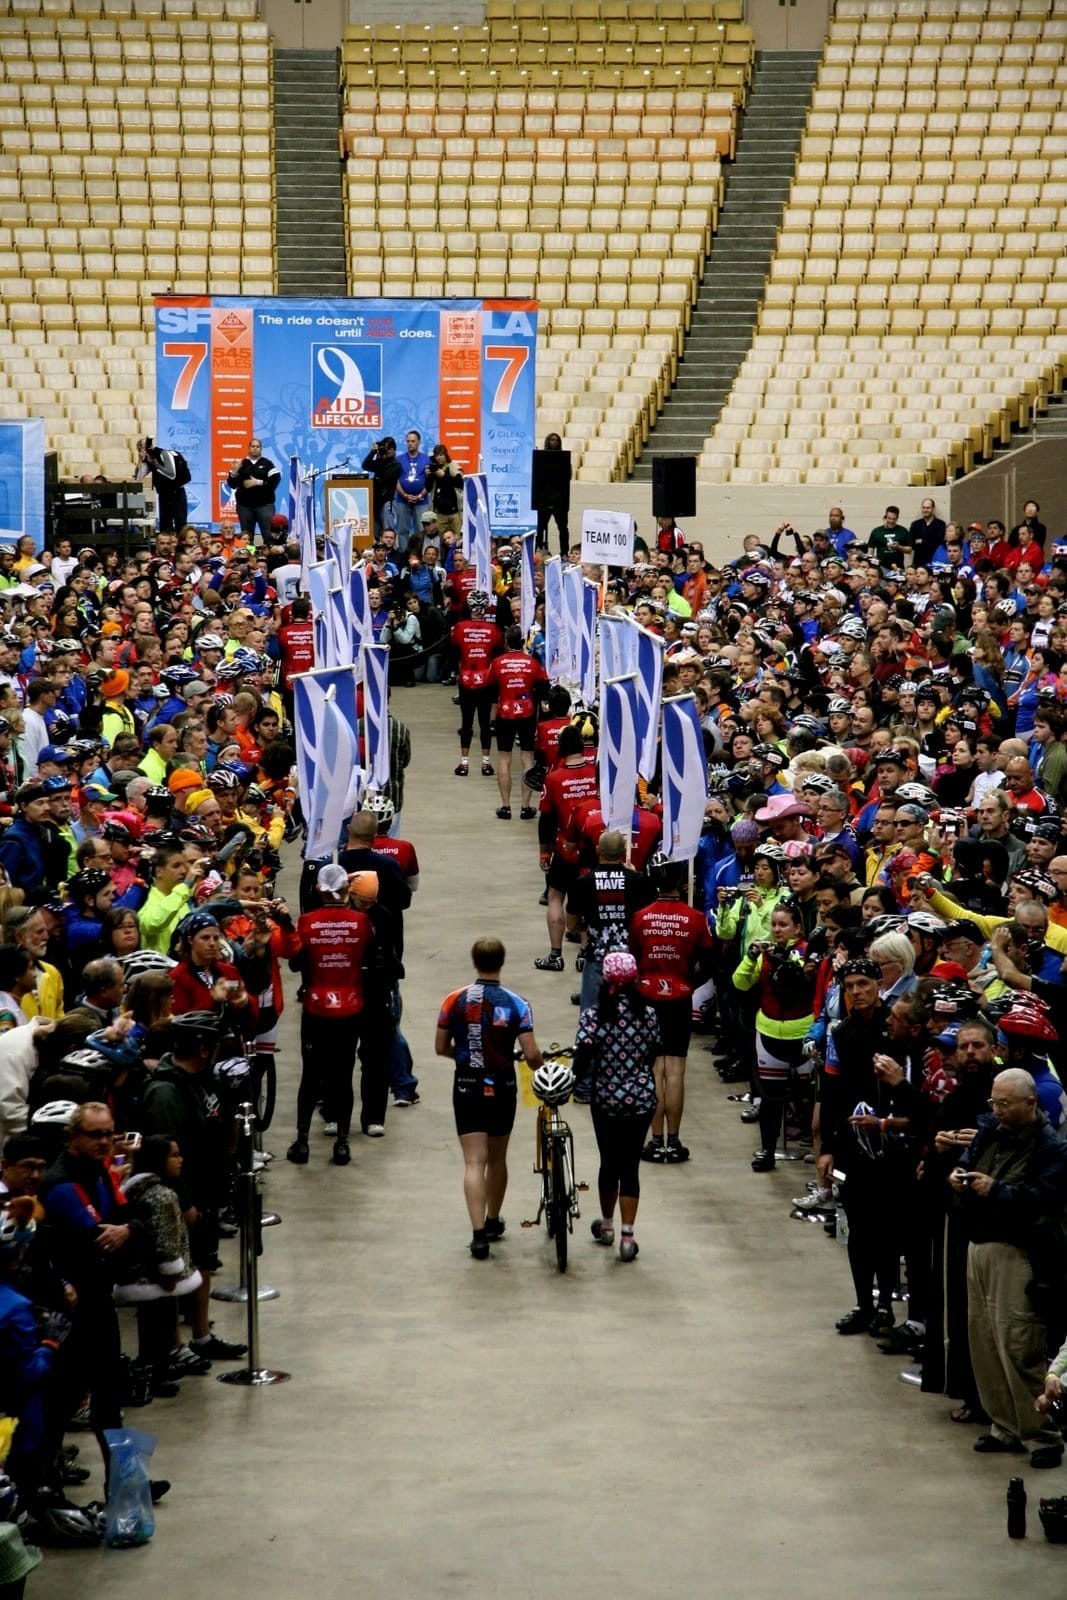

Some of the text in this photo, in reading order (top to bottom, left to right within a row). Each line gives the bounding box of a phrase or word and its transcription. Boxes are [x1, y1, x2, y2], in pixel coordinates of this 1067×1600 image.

[158, 307, 211, 334] SF
[259, 314, 393, 326] The ride doesn't end
[482, 311, 534, 336] LA
[335, 328, 436, 338] until AIDS does.
[213, 347, 252, 358] 545
[441, 350, 479, 360] 545
[213, 359, 252, 368] MILES
[441, 361, 479, 370] MILES
[163, 342, 208, 410] 7
[485, 345, 530, 412] 7
[315, 398, 379, 414] AIDS
[315, 415, 379, 426] LIFECYCLE
[585, 531, 627, 546] TEAM 100
[595, 879, 625, 890] HAVE
[643, 912, 689, 923] eliminating
[311, 921, 358, 929] eliminating
[651, 920, 680, 929] stigma
[320, 929, 349, 937] stigma
[310, 937, 343, 945] through
[322, 953, 348, 961] public
[318, 960, 351, 968] example
